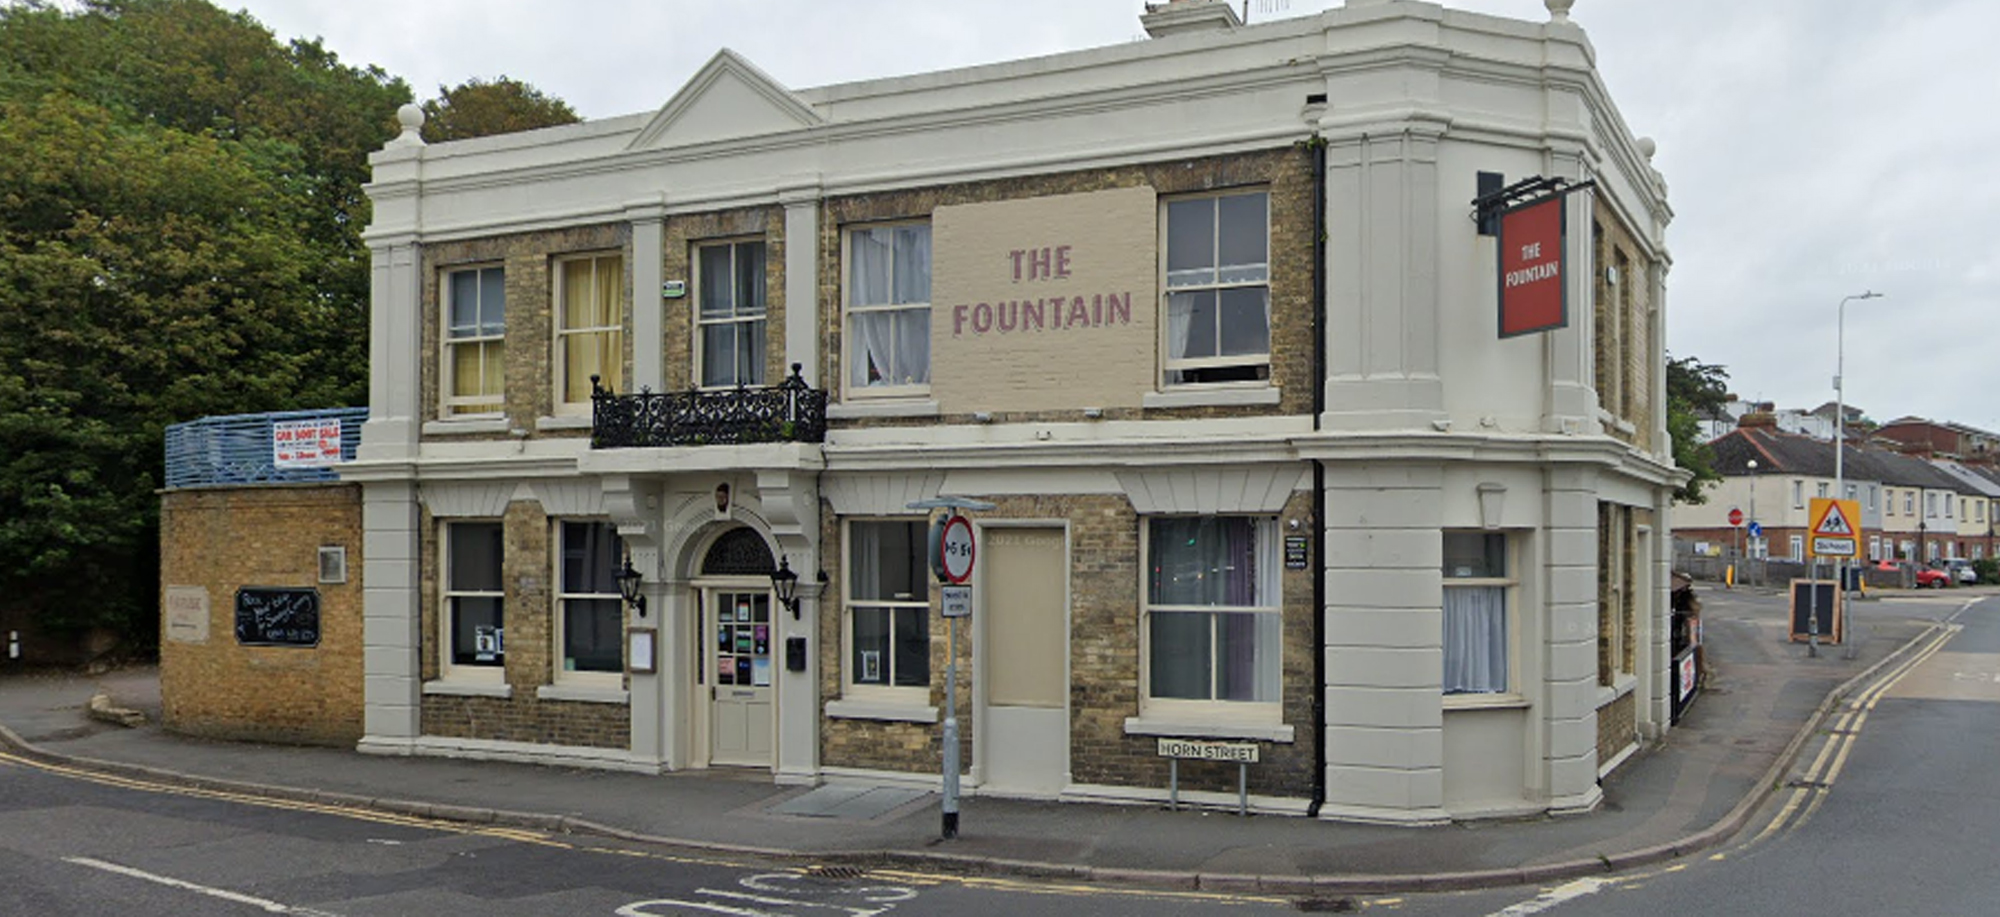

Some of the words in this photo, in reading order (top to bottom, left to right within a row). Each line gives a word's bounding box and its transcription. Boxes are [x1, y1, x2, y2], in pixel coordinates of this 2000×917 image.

[1521, 242, 1541, 260] THE
[1010, 245, 1072, 282] THE
[1505, 261, 1558, 287] FOUNTAIN
[952, 292, 1132, 338] FOUNTAIN
[276, 430, 293, 441] CAR
[295, 428, 317, 441] BOOT
[319, 426, 339, 438] SALE
[1817, 541, 1851, 551] School
[1161, 743, 1202, 756] HORN
[1205, 746, 1255, 761] STREET
